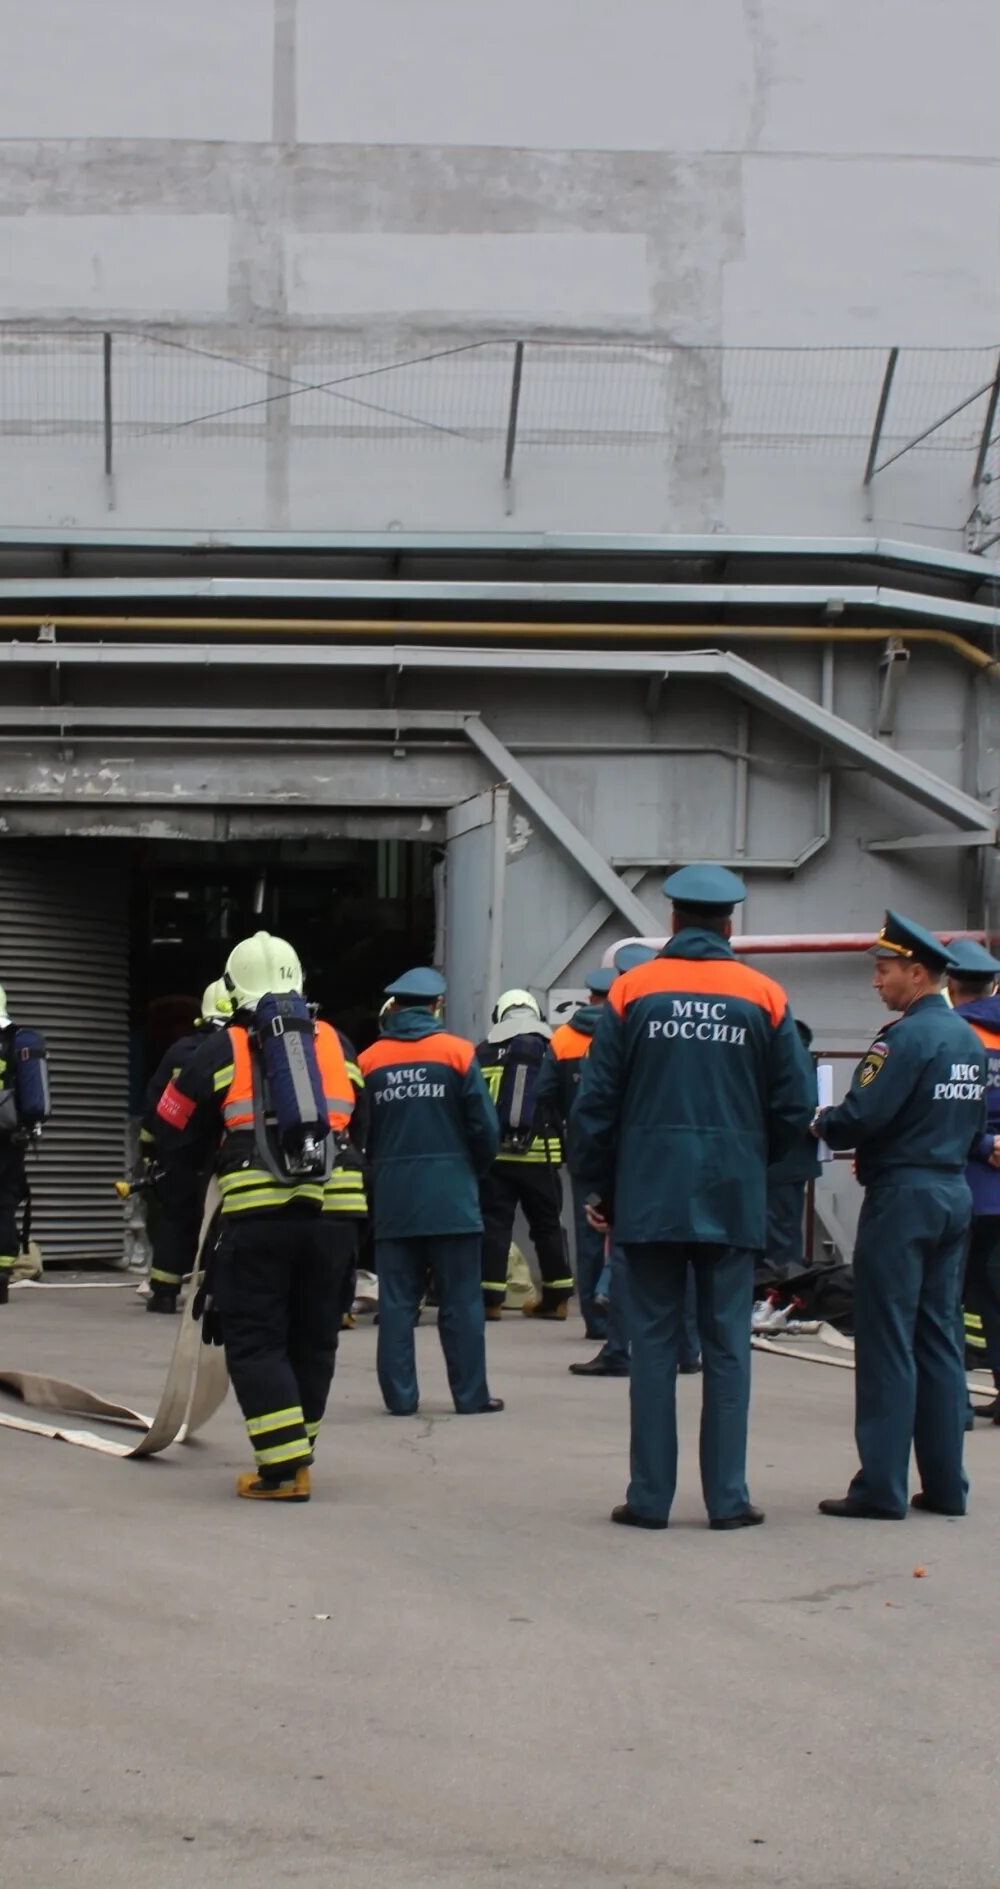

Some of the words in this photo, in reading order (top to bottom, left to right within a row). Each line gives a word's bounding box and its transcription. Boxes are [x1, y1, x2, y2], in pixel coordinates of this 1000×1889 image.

[279, 966, 294, 980] 14
[671, 1000, 727, 1021] МЧС
[648, 1020, 747, 1045] РОССИИ
[386, 1067, 427, 1086] МЧС
[950, 1063, 980, 1081] МЧС
[374, 1083, 446, 1104] РОССИИ
